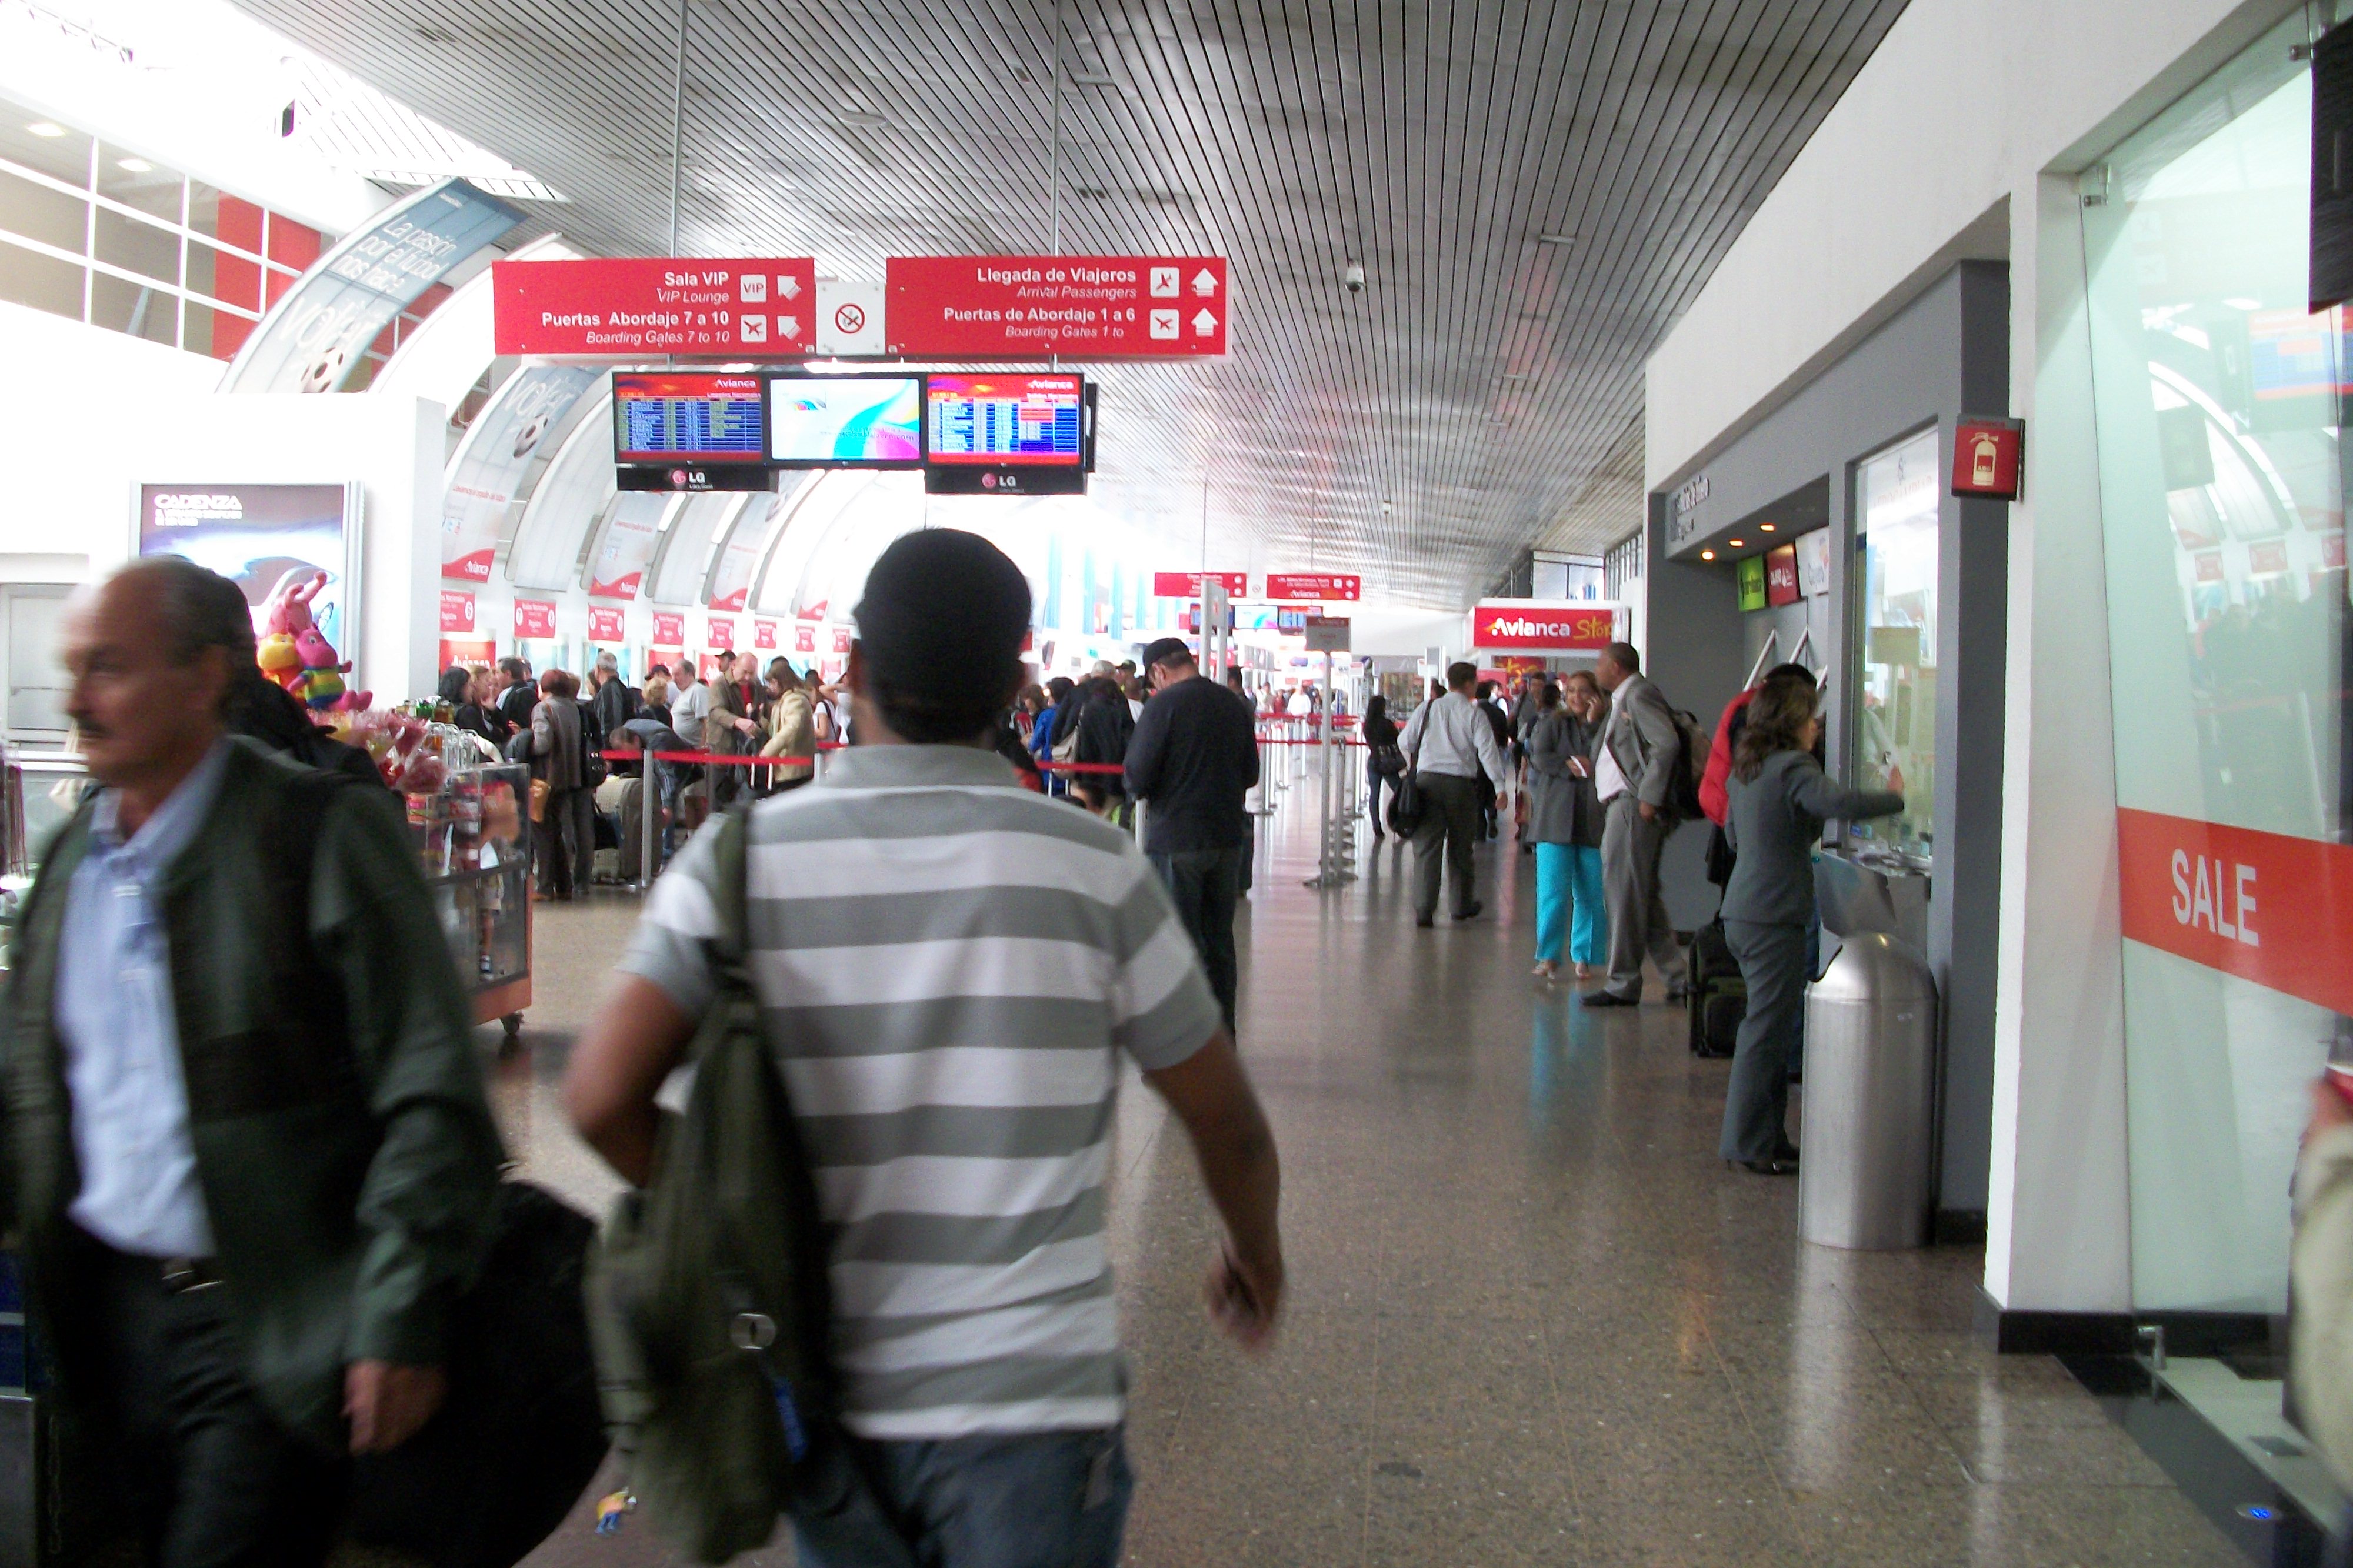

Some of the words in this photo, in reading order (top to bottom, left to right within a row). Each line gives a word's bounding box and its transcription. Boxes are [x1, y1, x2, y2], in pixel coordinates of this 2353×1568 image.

[383, 214, 413, 238] La
[665, 272, 698, 286] Sala
[702, 272, 729, 286] VIP
[978, 268, 1040, 285] Llegada
[1046, 268, 1065, 282] de
[1071, 268, 1136, 285] Viajeros
[744, 283, 764, 294] VIP
[1017, 285, 1058, 298] Arrival
[1062, 286, 1136, 300] Passengers
[657, 289, 680, 302] VIP
[683, 291, 729, 305] Lounge
[542, 312, 600, 326] Puertas
[609, 311, 679, 328] Abordaje
[684, 311, 692, 325] 7
[698, 314, 706, 325] a
[712, 311, 729, 325] 10
[944, 307, 1001, 321] Puertas
[1006, 308, 1023, 321] de
[1028, 308, 1095, 323] Abordaje
[1101, 308, 1106, 320] 1
[1114, 311, 1121, 321] a
[1126, 308, 1135, 321] 6
[586, 331, 641, 346] Boarding
[646, 330, 683, 345] Gates
[688, 331, 695, 343] 7
[699, 332, 710, 343] to
[716, 331, 729, 343] 10
[1006, 326, 1058, 339] Boarding
[1062, 325, 1096, 337] Gates
[1103, 326, 1108, 337] 1
[1112, 326, 1124, 337] to
[716, 379, 756, 388] Avianca
[1029, 379, 1074, 389] Avianca
[689, 472, 705, 484] LG
[999, 475, 1016, 487] LG
[154, 494, 243, 510] CADENZA
[1491, 617, 1571, 637] Avianca
[1573, 616, 1612, 641] Stor
[2171, 848, 2259, 947] SALE
